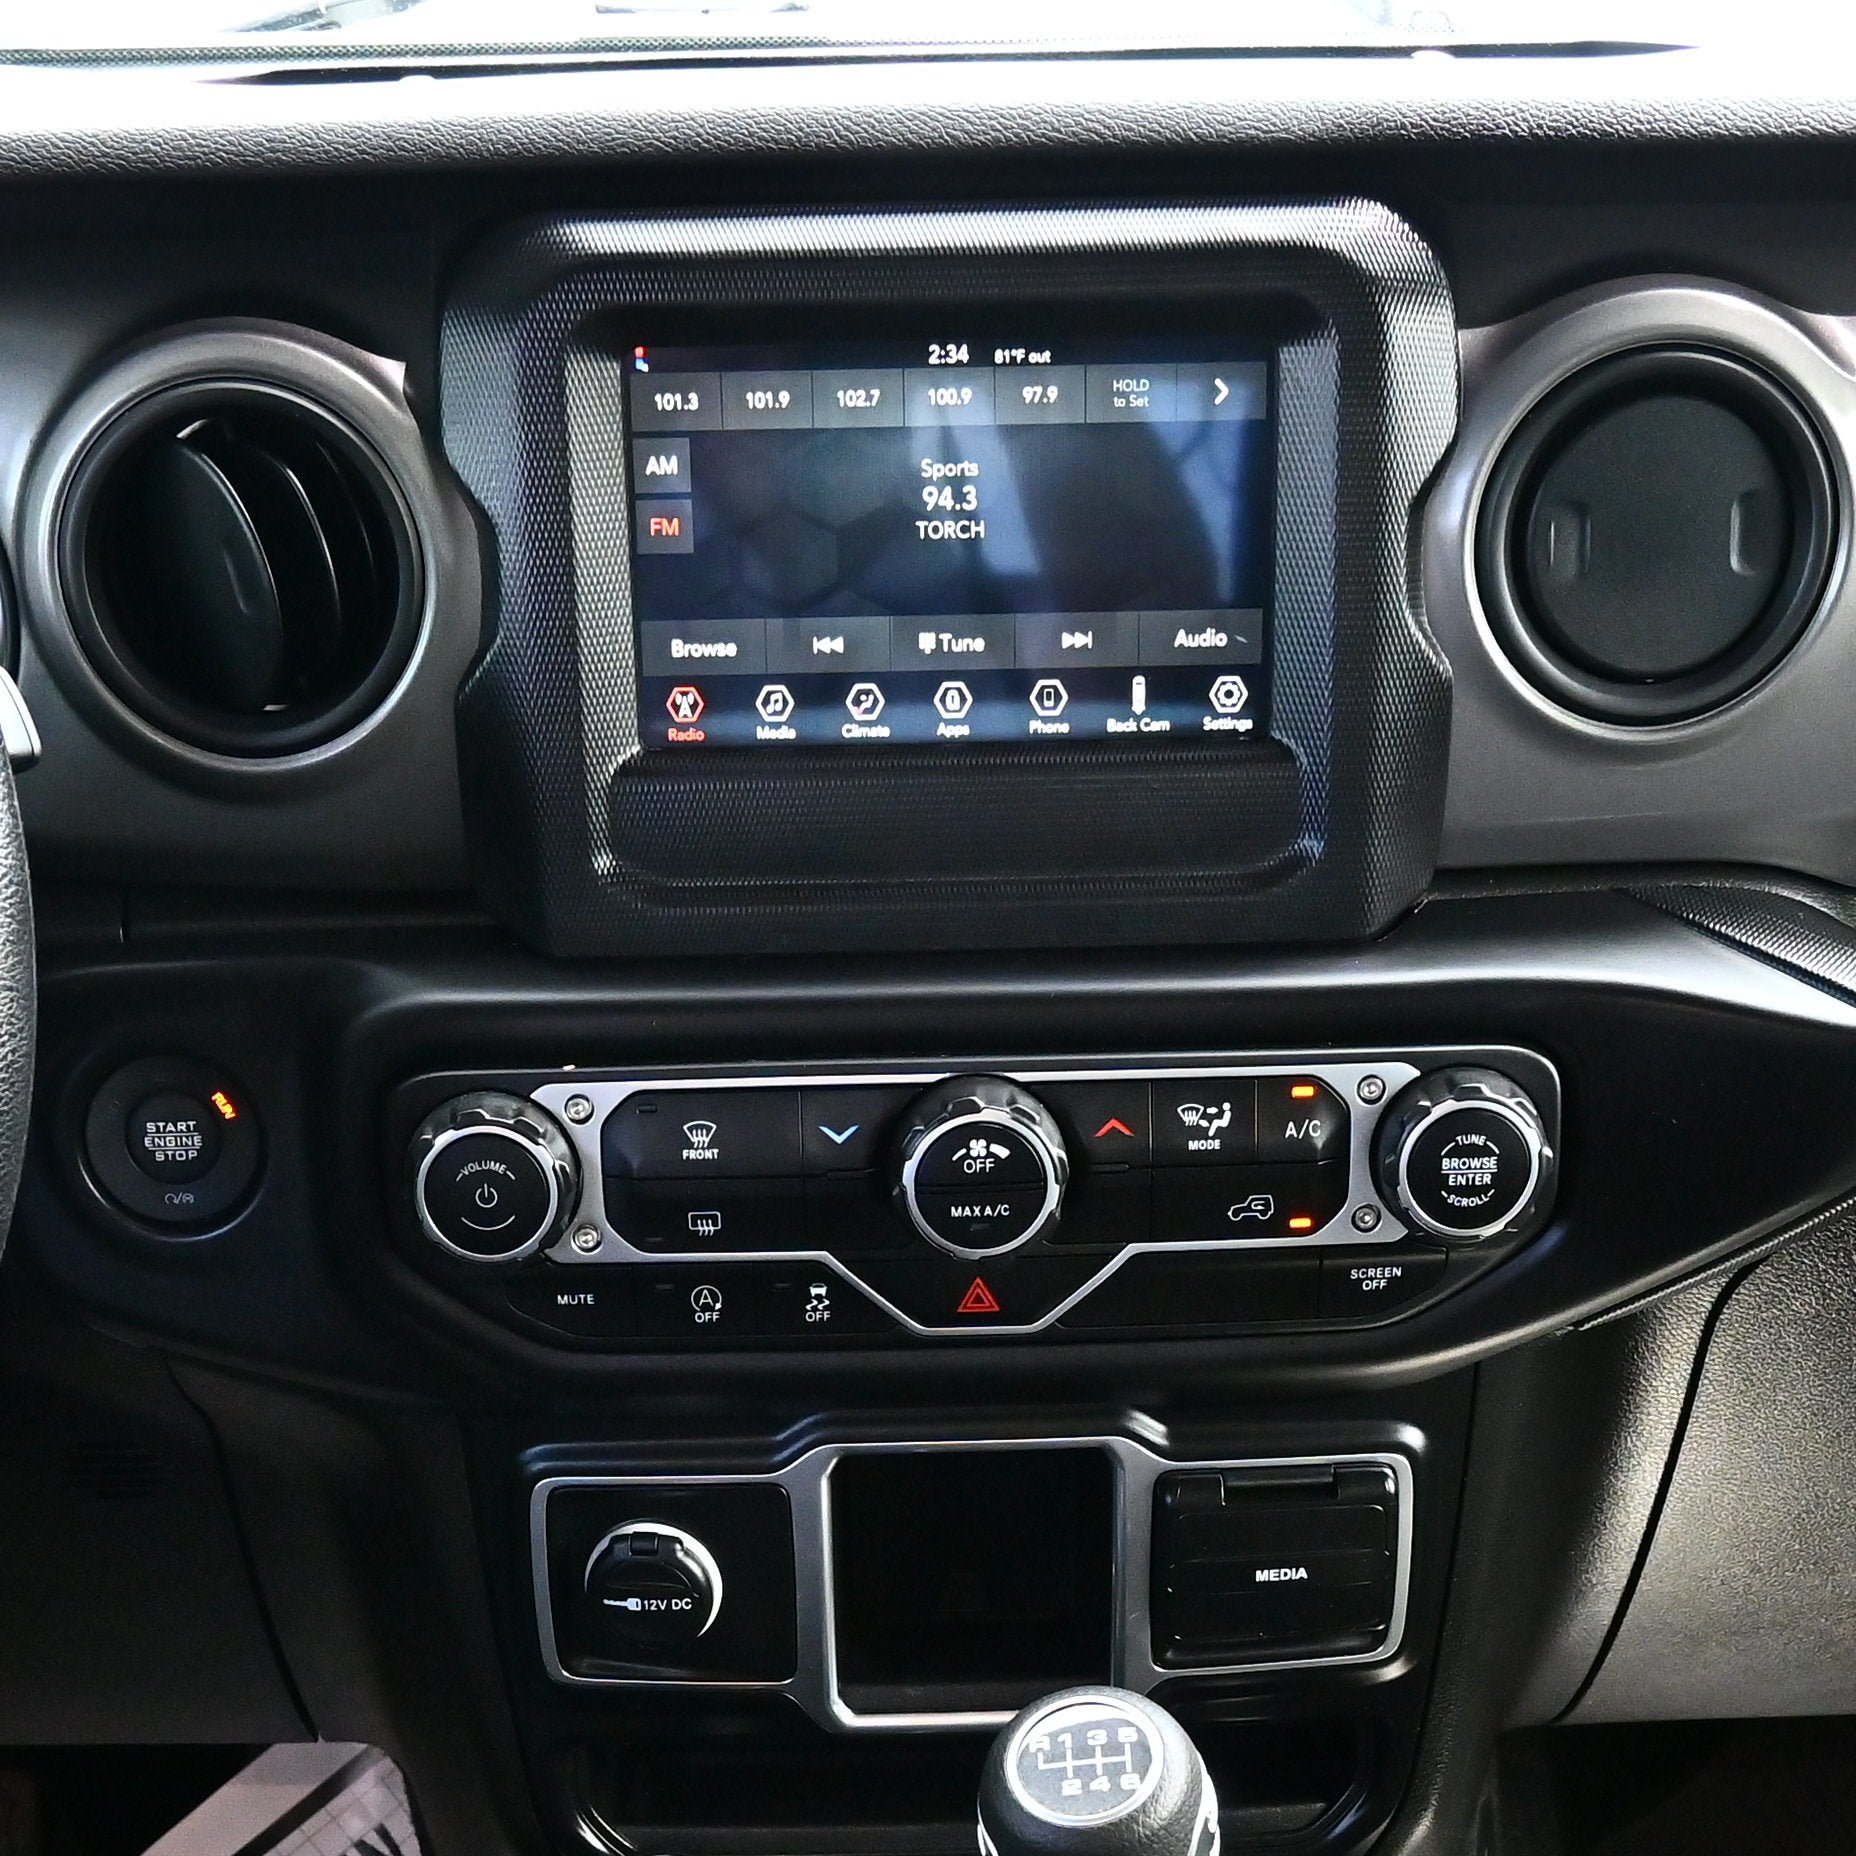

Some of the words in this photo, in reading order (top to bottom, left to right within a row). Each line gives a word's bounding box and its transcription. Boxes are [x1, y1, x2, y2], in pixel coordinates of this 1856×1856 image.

[928, 344, 969, 365] 2:34
[1028, 350, 1051, 364] out
[1113, 378, 1149, 393] HOLD
[654, 392, 698, 411] 101.3
[746, 391, 790, 410] 101.9
[837, 389, 880, 408] 102.7
[928, 387, 972, 406] 100.9
[1022, 385, 1058, 404] 97.9
[1113, 395, 1126, 408] to
[1129, 394, 1149, 408] Set
[646, 456, 678, 476] AM
[921, 457, 979, 482] Sports
[922, 485, 978, 511] 94.3
[650, 518, 679, 538] FM
[914, 520, 985, 541] TORCH
[939, 633, 985, 653] Tune
[1174, 627, 1228, 648] Audio
[671, 639, 737, 659] Browse
[841, 724, 890, 739] Climate
[937, 723, 970, 738] Apps
[1029, 721, 1070, 735] Phone
[1106, 718, 1137, 733] Back
[1140, 718, 1170, 732] Cam
[1203, 716, 1253, 732] Settings
[668, 728, 705, 742] Radio
[756, 726, 796, 740] Media
[211, 1091, 237, 1120] RUN
[146, 1121, 197, 1133] START
[1284, 1119, 1322, 1140] A/C
[144, 1136, 203, 1148] ENGINE
[1188, 1138, 1221, 1151] MODE
[1455, 1133, 1486, 1147] TUNE
[155, 1150, 198, 1162] STOP
[682, 1148, 720, 1160] FRONT
[461, 1161, 508, 1176] VOLUME
[963, 1158, 995, 1174] OFF
[1442, 1155, 1498, 1171] BROWSE
[1448, 1172, 1492, 1186] ENTER
[1447, 1191, 1491, 1208] SCROLL
[951, 1205, 981, 1217] MAX
[983, 1203, 1010, 1217] A/C
[1350, 1266, 1402, 1279] SCREEN
[1362, 1278, 1388, 1291] OFF
[557, 1294, 595, 1305] MUTE
[694, 1311, 720, 1323] OFF
[805, 1310, 831, 1322] OFF
[1255, 1567, 1308, 1582] MEDIA
[644, 1599, 667, 1611] 12V
[671, 1598, 692, 1610] DC
[1057, 1732, 1072, 1749] 1
[1087, 1729, 1107, 1745] 3
[1117, 1726, 1139, 1743] 5
[1061, 1778, 1082, 1796] 2
[1089, 1775, 1111, 1792] 4
[1120, 1773, 1141, 1790] 6
